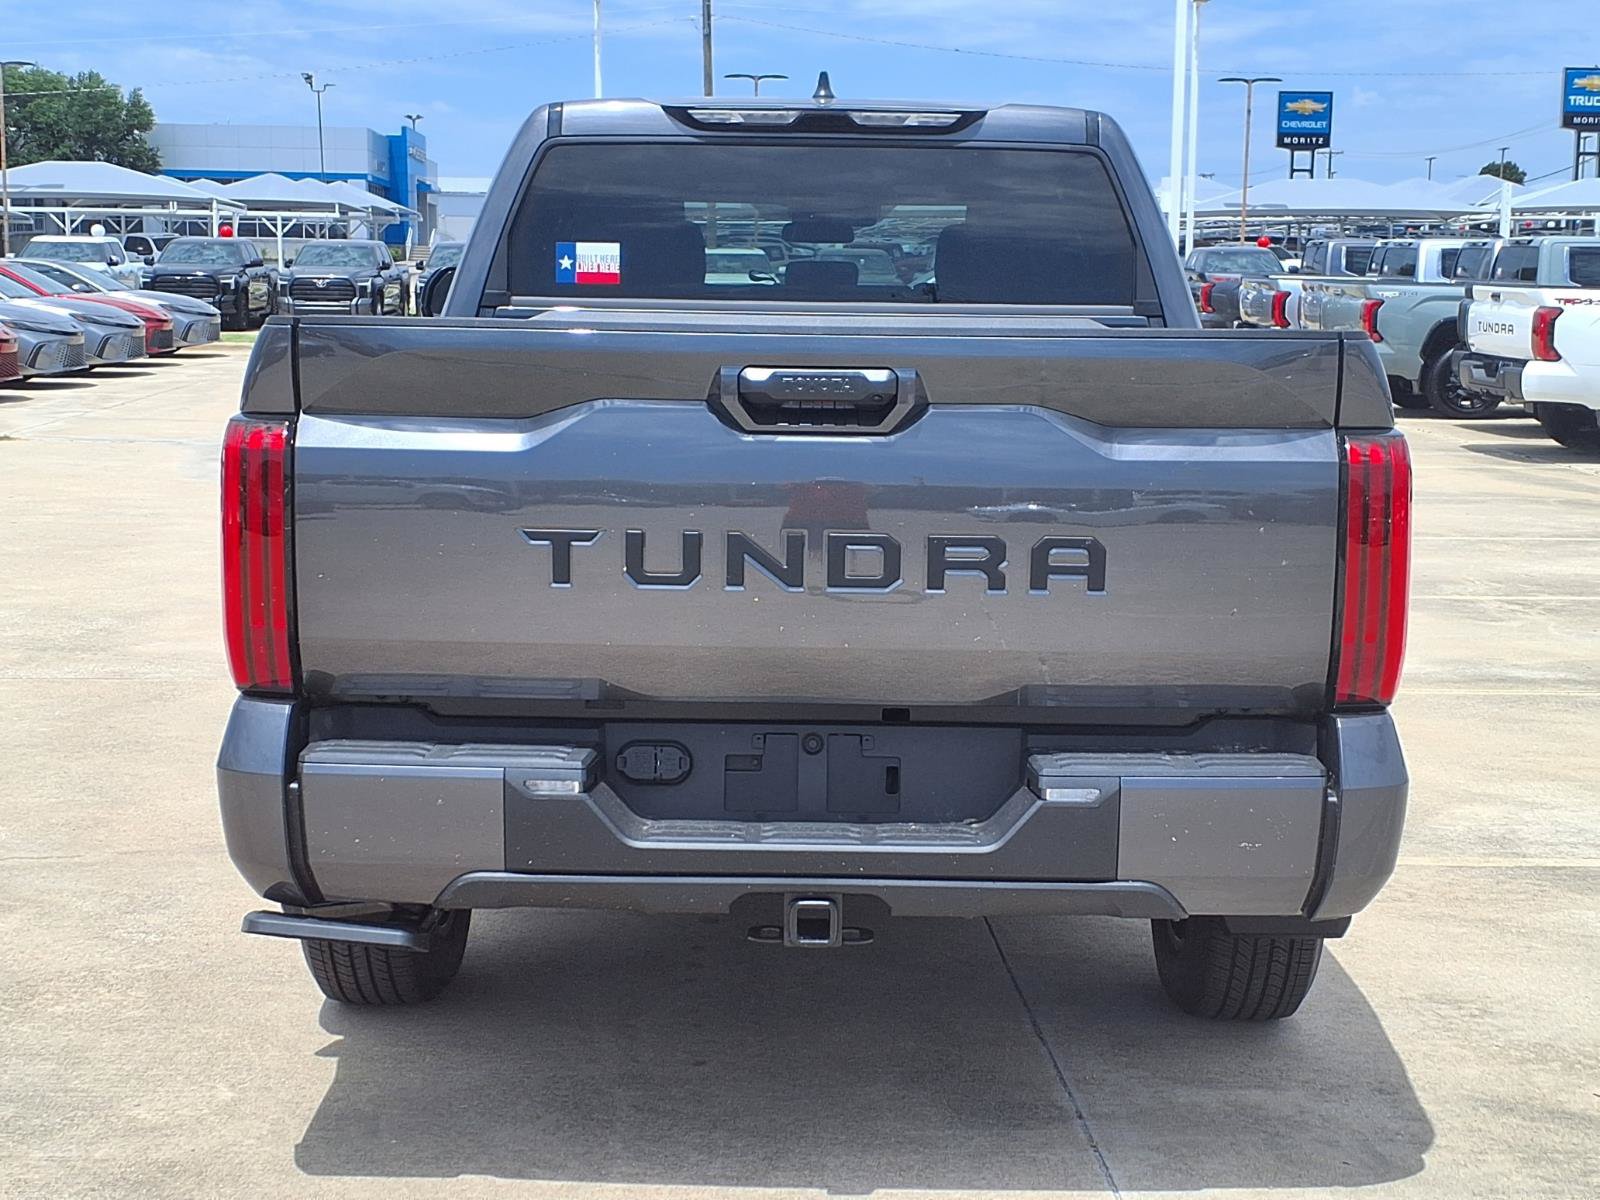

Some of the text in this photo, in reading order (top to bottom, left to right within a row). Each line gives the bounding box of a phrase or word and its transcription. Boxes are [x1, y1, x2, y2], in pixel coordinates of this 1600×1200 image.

[1281, 120, 1327, 129] CHEVROLET
[1283, 136, 1324, 144] MORITZ
[1478, 321, 1514, 335] TUNDRA
[516, 528, 1108, 596] TUNDRA
